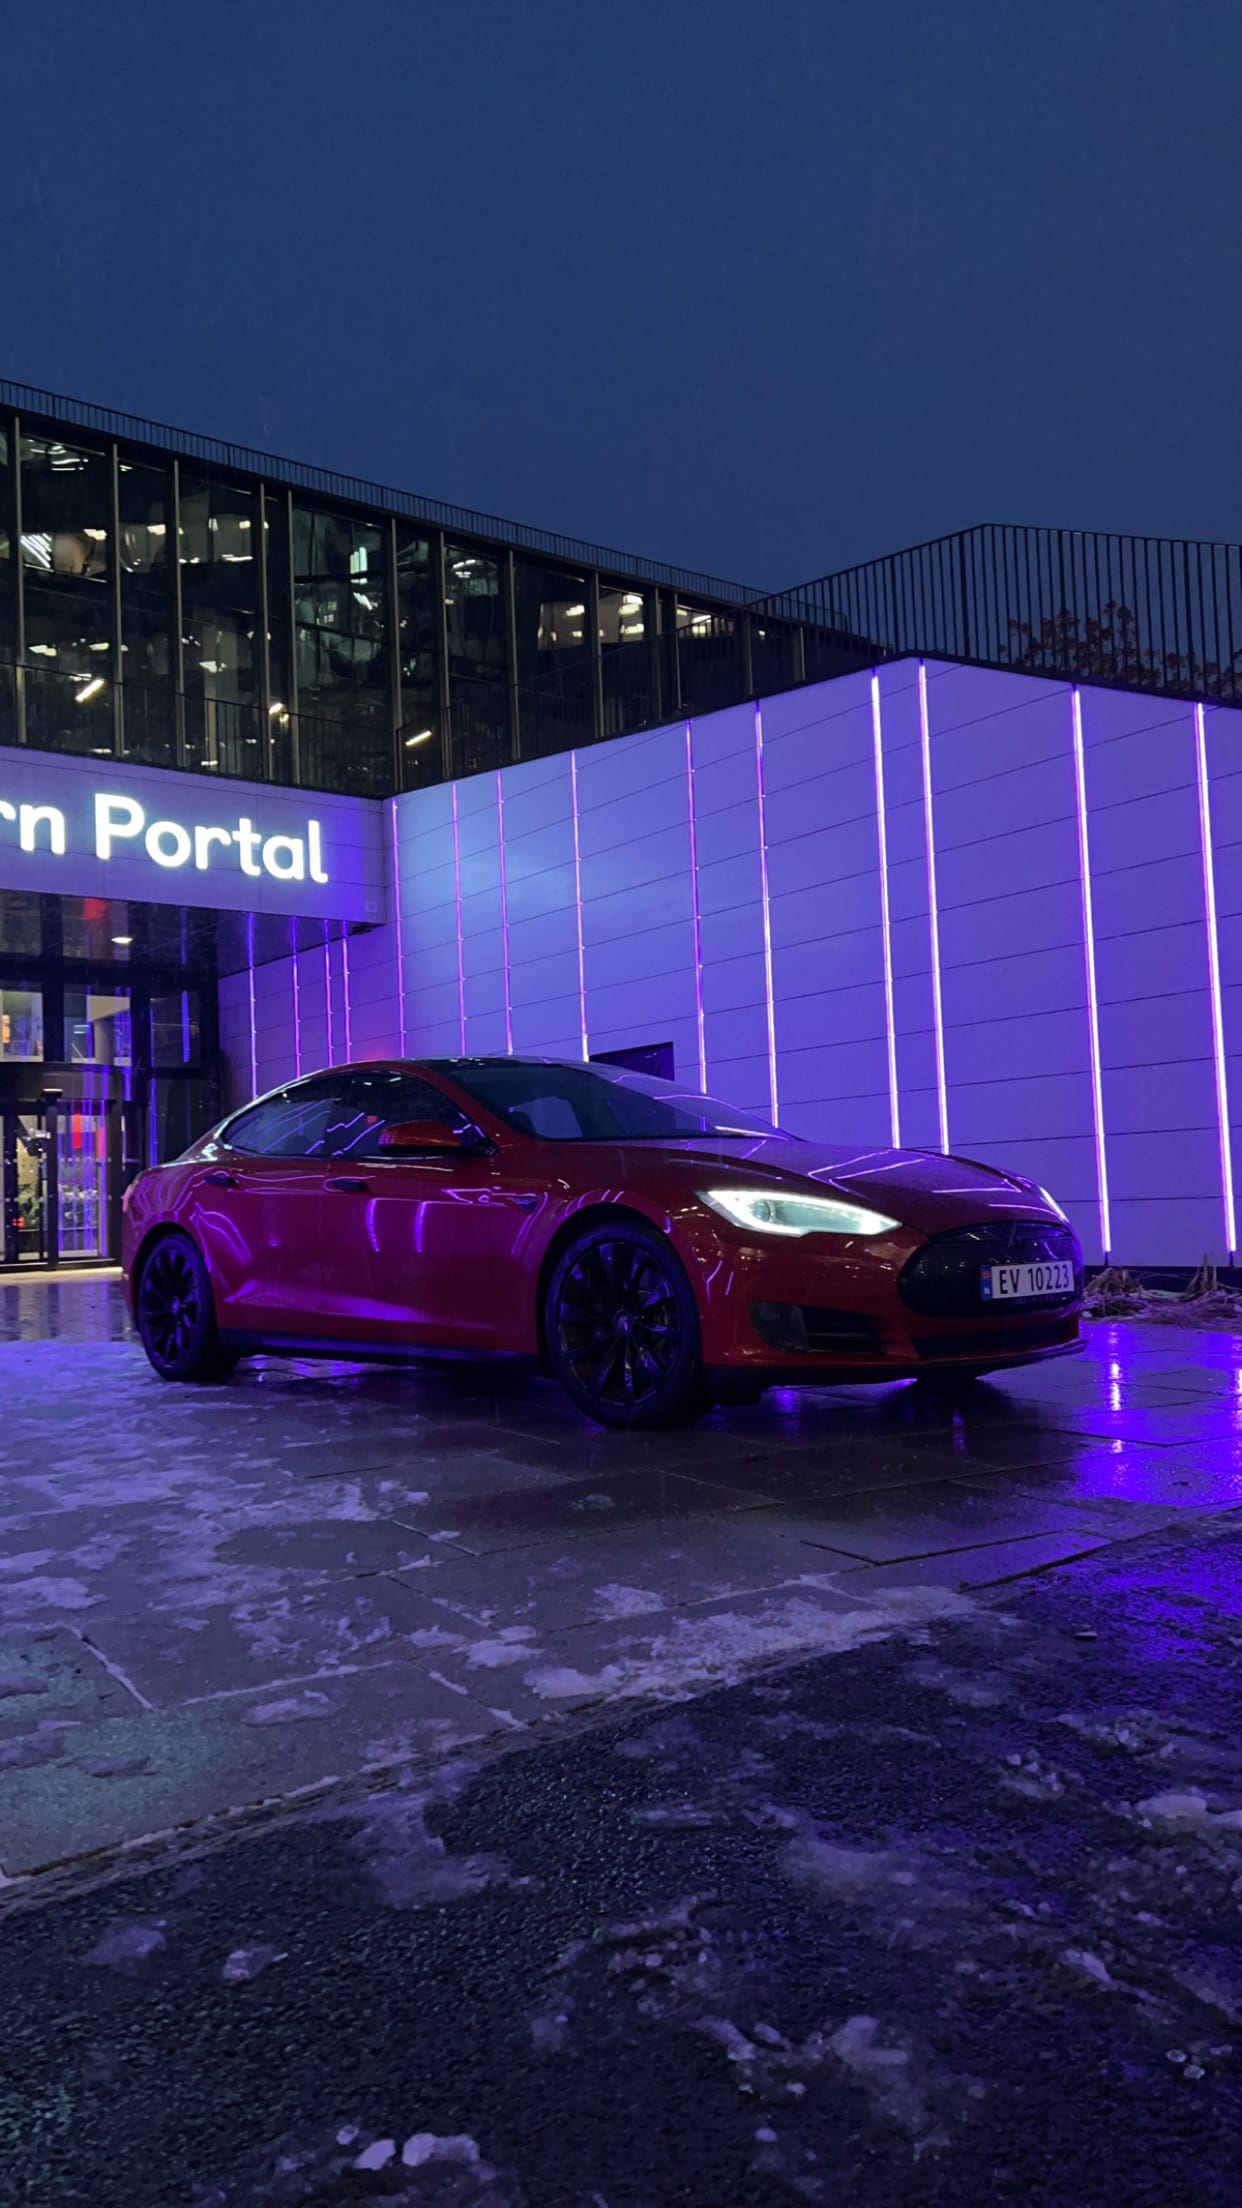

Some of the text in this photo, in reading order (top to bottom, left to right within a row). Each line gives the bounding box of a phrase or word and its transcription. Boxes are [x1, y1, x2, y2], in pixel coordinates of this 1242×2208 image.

[95, 793, 328, 883] Portal
[999, 1264, 1070, 1295] EV 10223
